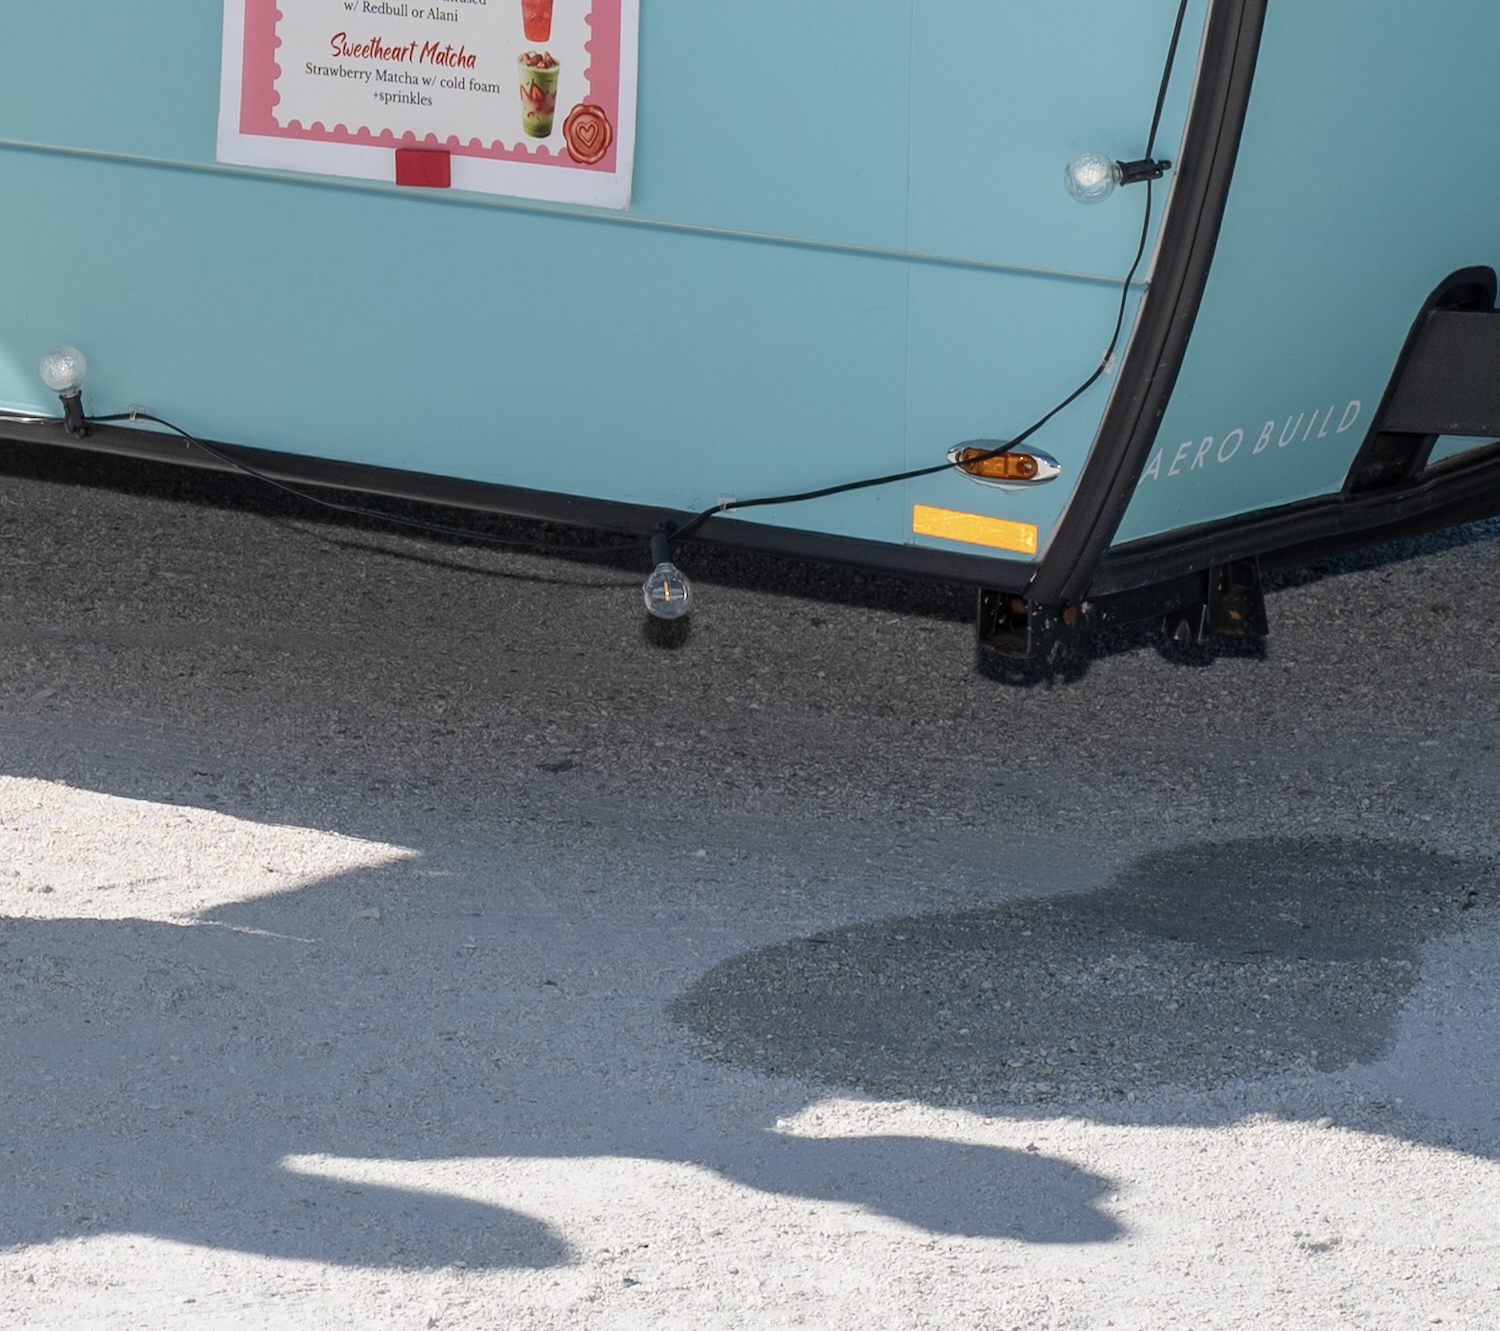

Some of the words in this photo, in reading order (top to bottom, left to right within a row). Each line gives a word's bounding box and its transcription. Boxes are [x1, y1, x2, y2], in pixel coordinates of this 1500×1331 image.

[330, 32, 417, 63] Sweetheart
[419, 41, 477, 69] Matcha
[1140, 428, 1244, 484] AERO
[1252, 400, 1362, 456] BUILD
